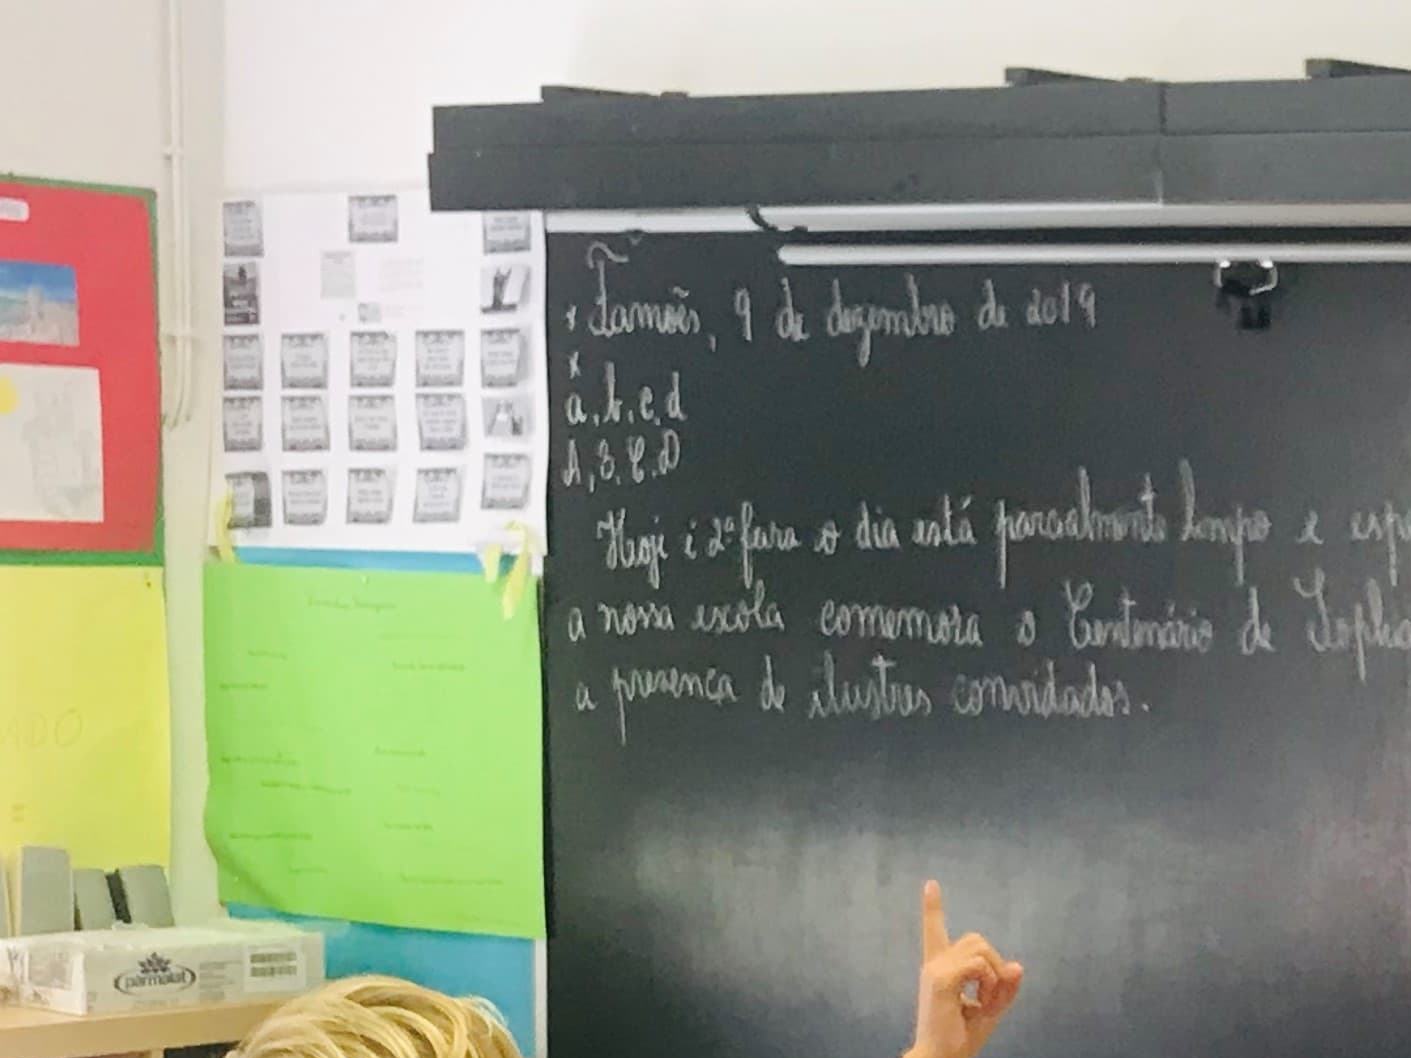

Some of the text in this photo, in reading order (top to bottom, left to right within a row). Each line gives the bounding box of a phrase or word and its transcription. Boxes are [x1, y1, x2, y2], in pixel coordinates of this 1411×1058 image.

[775, 277, 810, 342] de
[827, 272, 956, 368] dezembro
[979, 279, 1009, 331] de
[597, 508, 668, 590] Hoje
[856, 501, 900, 551] dia
[912, 494, 977, 546] está
[1296, 510, 1324, 544] e
[568, 606, 587, 643] a
[599, 601, 675, 636] nossa
[691, 579, 785, 634] escola
[820, 600, 984, 646] comemora
[1016, 609, 1036, 647] o
[1241, 586, 1276, 656] de
[576, 683, 598, 711] a
[761, 654, 785, 713] de
